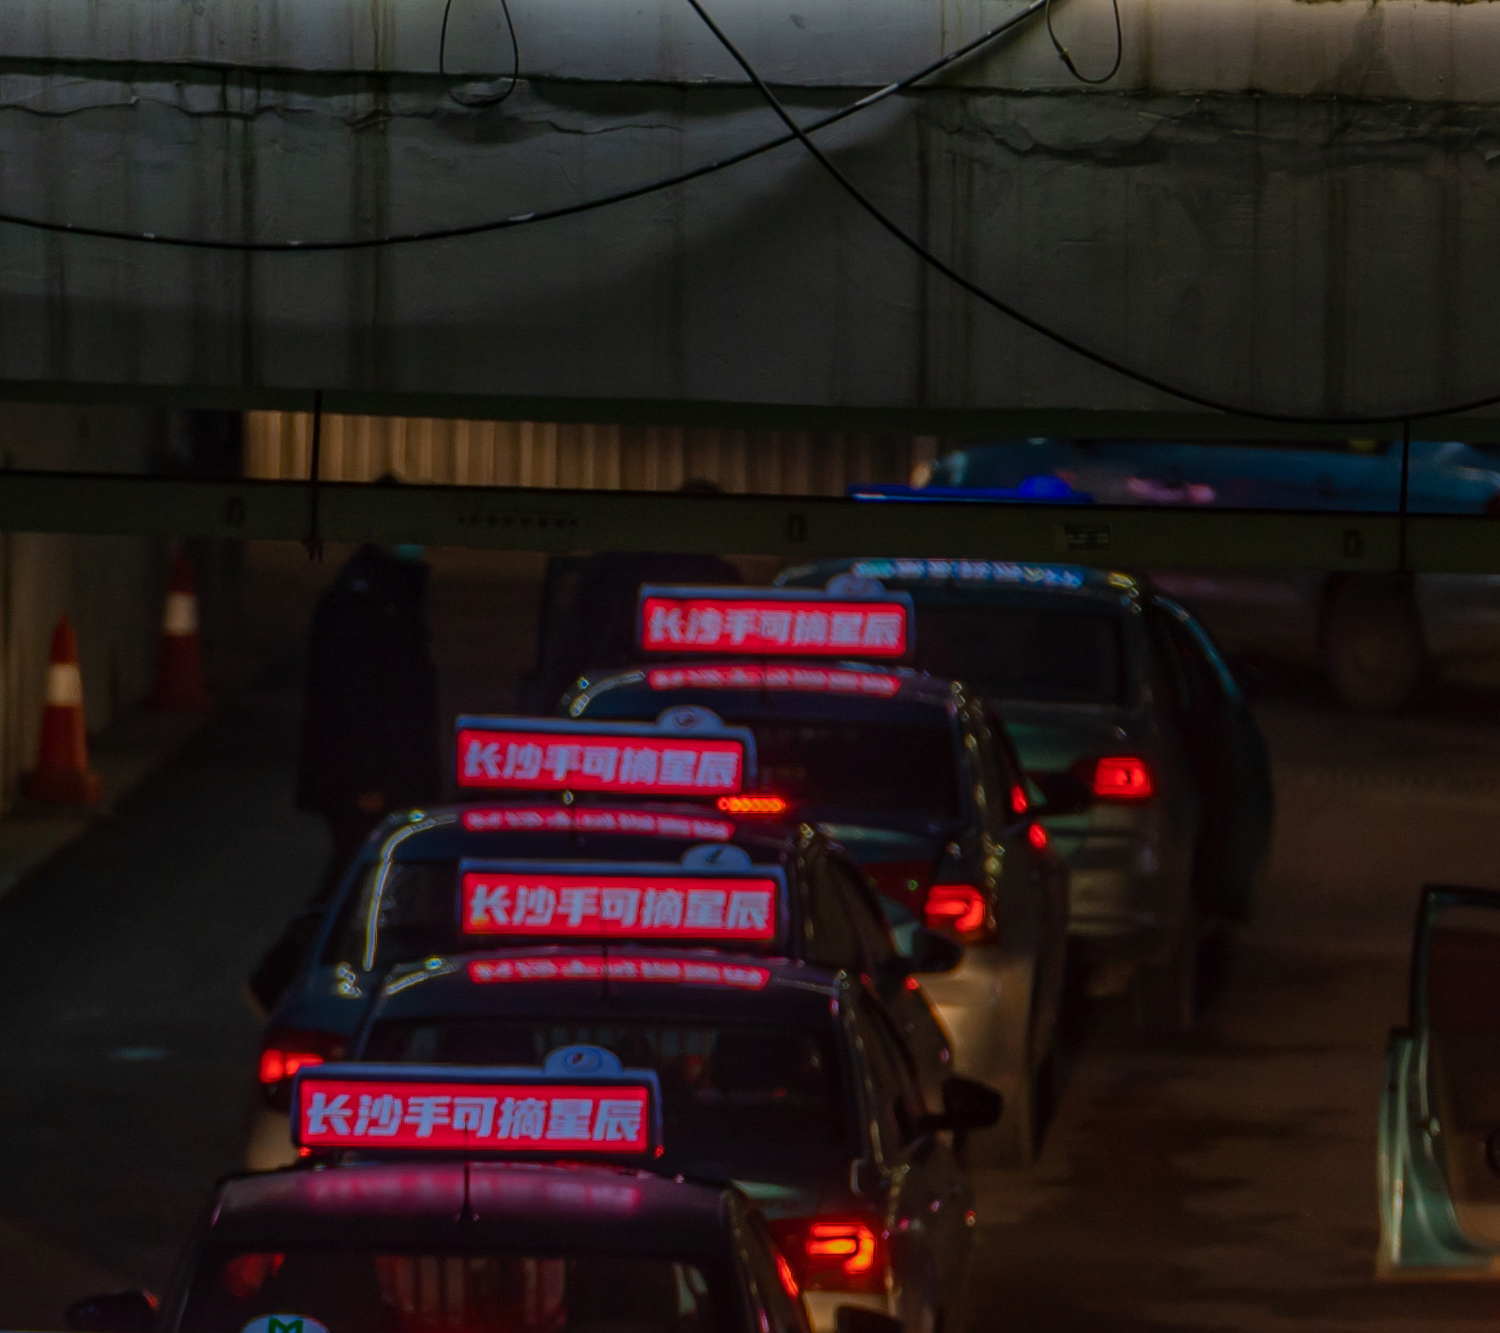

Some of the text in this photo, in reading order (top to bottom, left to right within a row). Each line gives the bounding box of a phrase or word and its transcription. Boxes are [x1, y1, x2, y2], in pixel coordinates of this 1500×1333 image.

[467, 742, 737, 786] 长沙手可摘星辰
[471, 886, 769, 929] 长沙手可摘星辰
[308, 1093, 642, 1140] 长沙手可摘星辰
